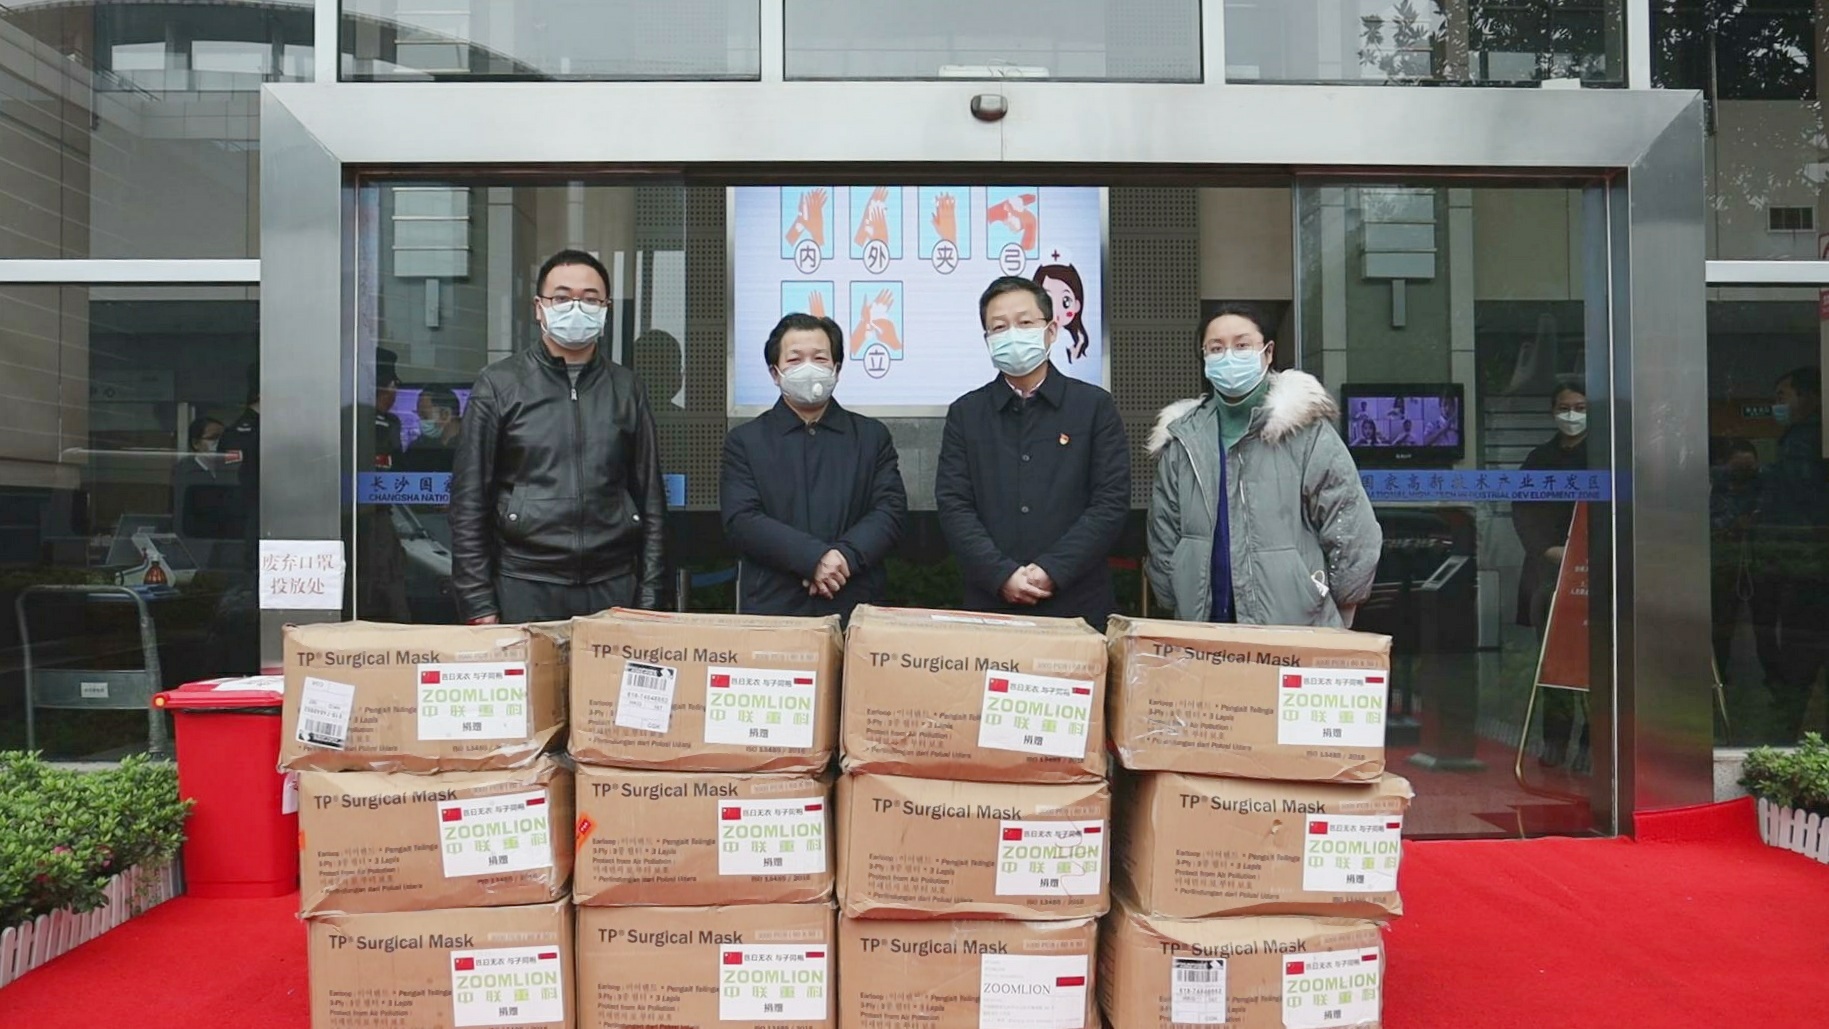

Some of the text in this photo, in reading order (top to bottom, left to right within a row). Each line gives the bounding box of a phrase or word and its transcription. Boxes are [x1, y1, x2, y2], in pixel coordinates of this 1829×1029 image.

[799, 247, 816, 266] 内
[868, 246, 886, 268] 外
[936, 246, 954, 268] 夹
[1005, 250, 1022, 271] 弓
[868, 350, 885, 372] 立
[1361, 473, 1601, 491] 国家高新技术产业开发区
[369, 494, 420, 502] CHANGSHA
[263, 554, 335, 571] 废弃口罩
[271, 578, 325, 594] 投放处
[325, 651, 390, 668] Surgical
[396, 651, 440, 664] Mask
[622, 645, 687, 663] Surgical
[694, 649, 737, 663] Mask
[1185, 647, 1250, 665] Surgical
[1257, 652, 1301, 667] Mask
[901, 654, 968, 672] Surgical
[975, 658, 1019, 672] Mask
[423, 688, 523, 703] ZOOMLION
[711, 693, 811, 710] ZOOMLION
[1283, 694, 1382, 710] ZOOMLION
[422, 704, 523, 718] 中联重科
[710, 709, 810, 725] 中联重科
[987, 697, 1087, 721] ZOOMLION
[1282, 710, 1381, 725] 中联重科
[985, 713, 1084, 736] 中联重科
[342, 792, 406, 809] Surgical
[412, 789, 457, 804] Mask
[621, 783, 688, 800] Surgical
[694, 783, 740, 797] Mask
[903, 800, 970, 819] Surgical
[977, 805, 1021, 820] Mask
[1211, 796, 1276, 814] Surgical
[1283, 799, 1325, 813] Mask
[445, 816, 545, 840] ZOOMLION
[723, 823, 821, 839] ZOOMLION
[446, 832, 546, 855] 中联重科
[723, 838, 821, 853] 中联重科
[1002, 845, 1099, 859] ZOOMLION
[1309, 840, 1398, 855] ZOOMLION
[1000, 861, 1097, 874] 中联重科
[1308, 857, 1396, 870] 中联重科
[357, 935, 422, 952] Surgical
[429, 934, 473, 948] Mask
[628, 930, 692, 946] Surgical
[699, 931, 742, 944] Mask
[890, 939, 957, 956] Surgical
[964, 940, 1007, 954] Mask
[1192, 941, 1258, 958] Surgical
[1264, 939, 1306, 955] Mask
[456, 971, 557, 990] ZOOMLION
[724, 970, 823, 984] ZOOMLION
[1287, 973, 1375, 993] ZOOMLION
[457, 987, 558, 1005] 中联重科
[724, 986, 822, 998] 中联重科
[984, 983, 1051, 995] ZOOMLION
[1287, 989, 1375, 1007] 中联重科
